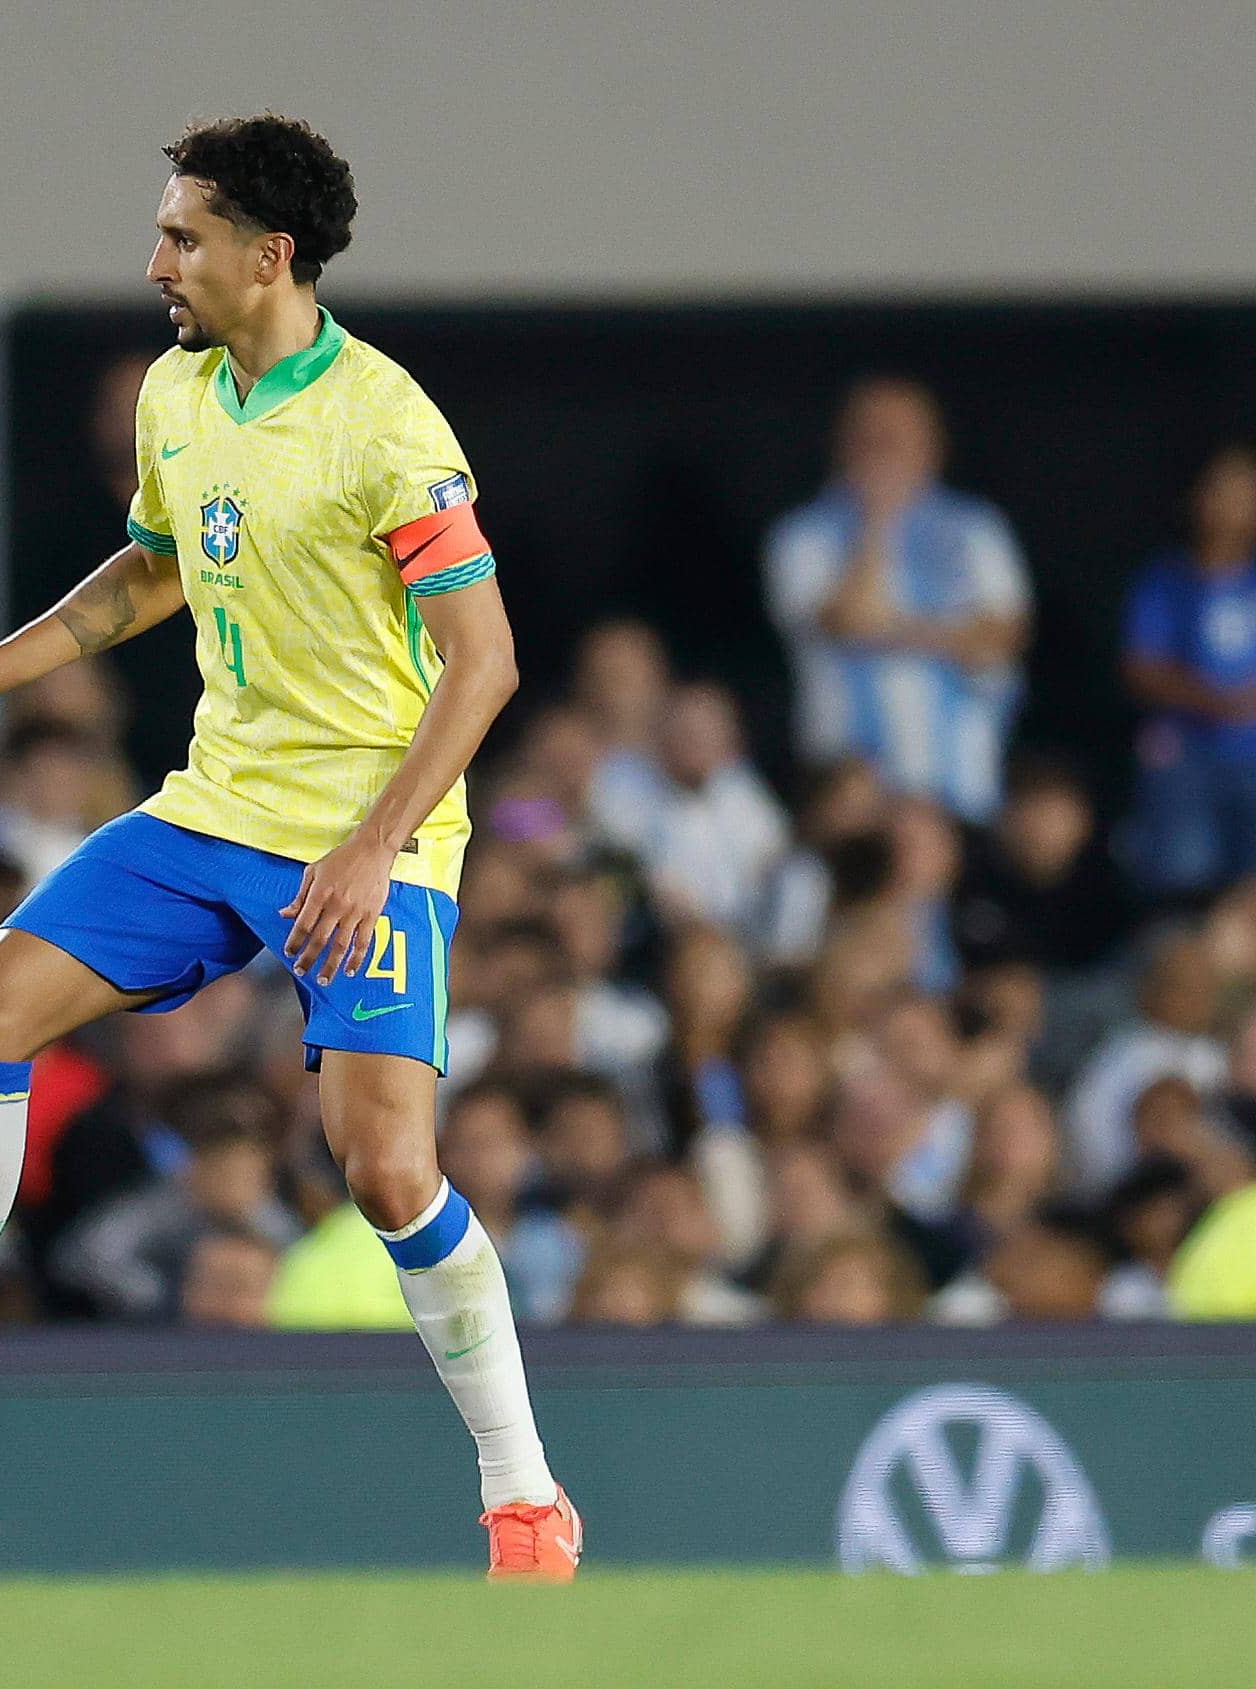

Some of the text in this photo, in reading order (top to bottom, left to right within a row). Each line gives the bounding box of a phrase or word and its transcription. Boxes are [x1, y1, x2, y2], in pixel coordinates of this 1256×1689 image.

[213, 524, 229, 534] CBF
[200, 569, 244, 589] BRASIL
[212, 606, 247, 687] 4
[364, 915, 407, 994] 4
